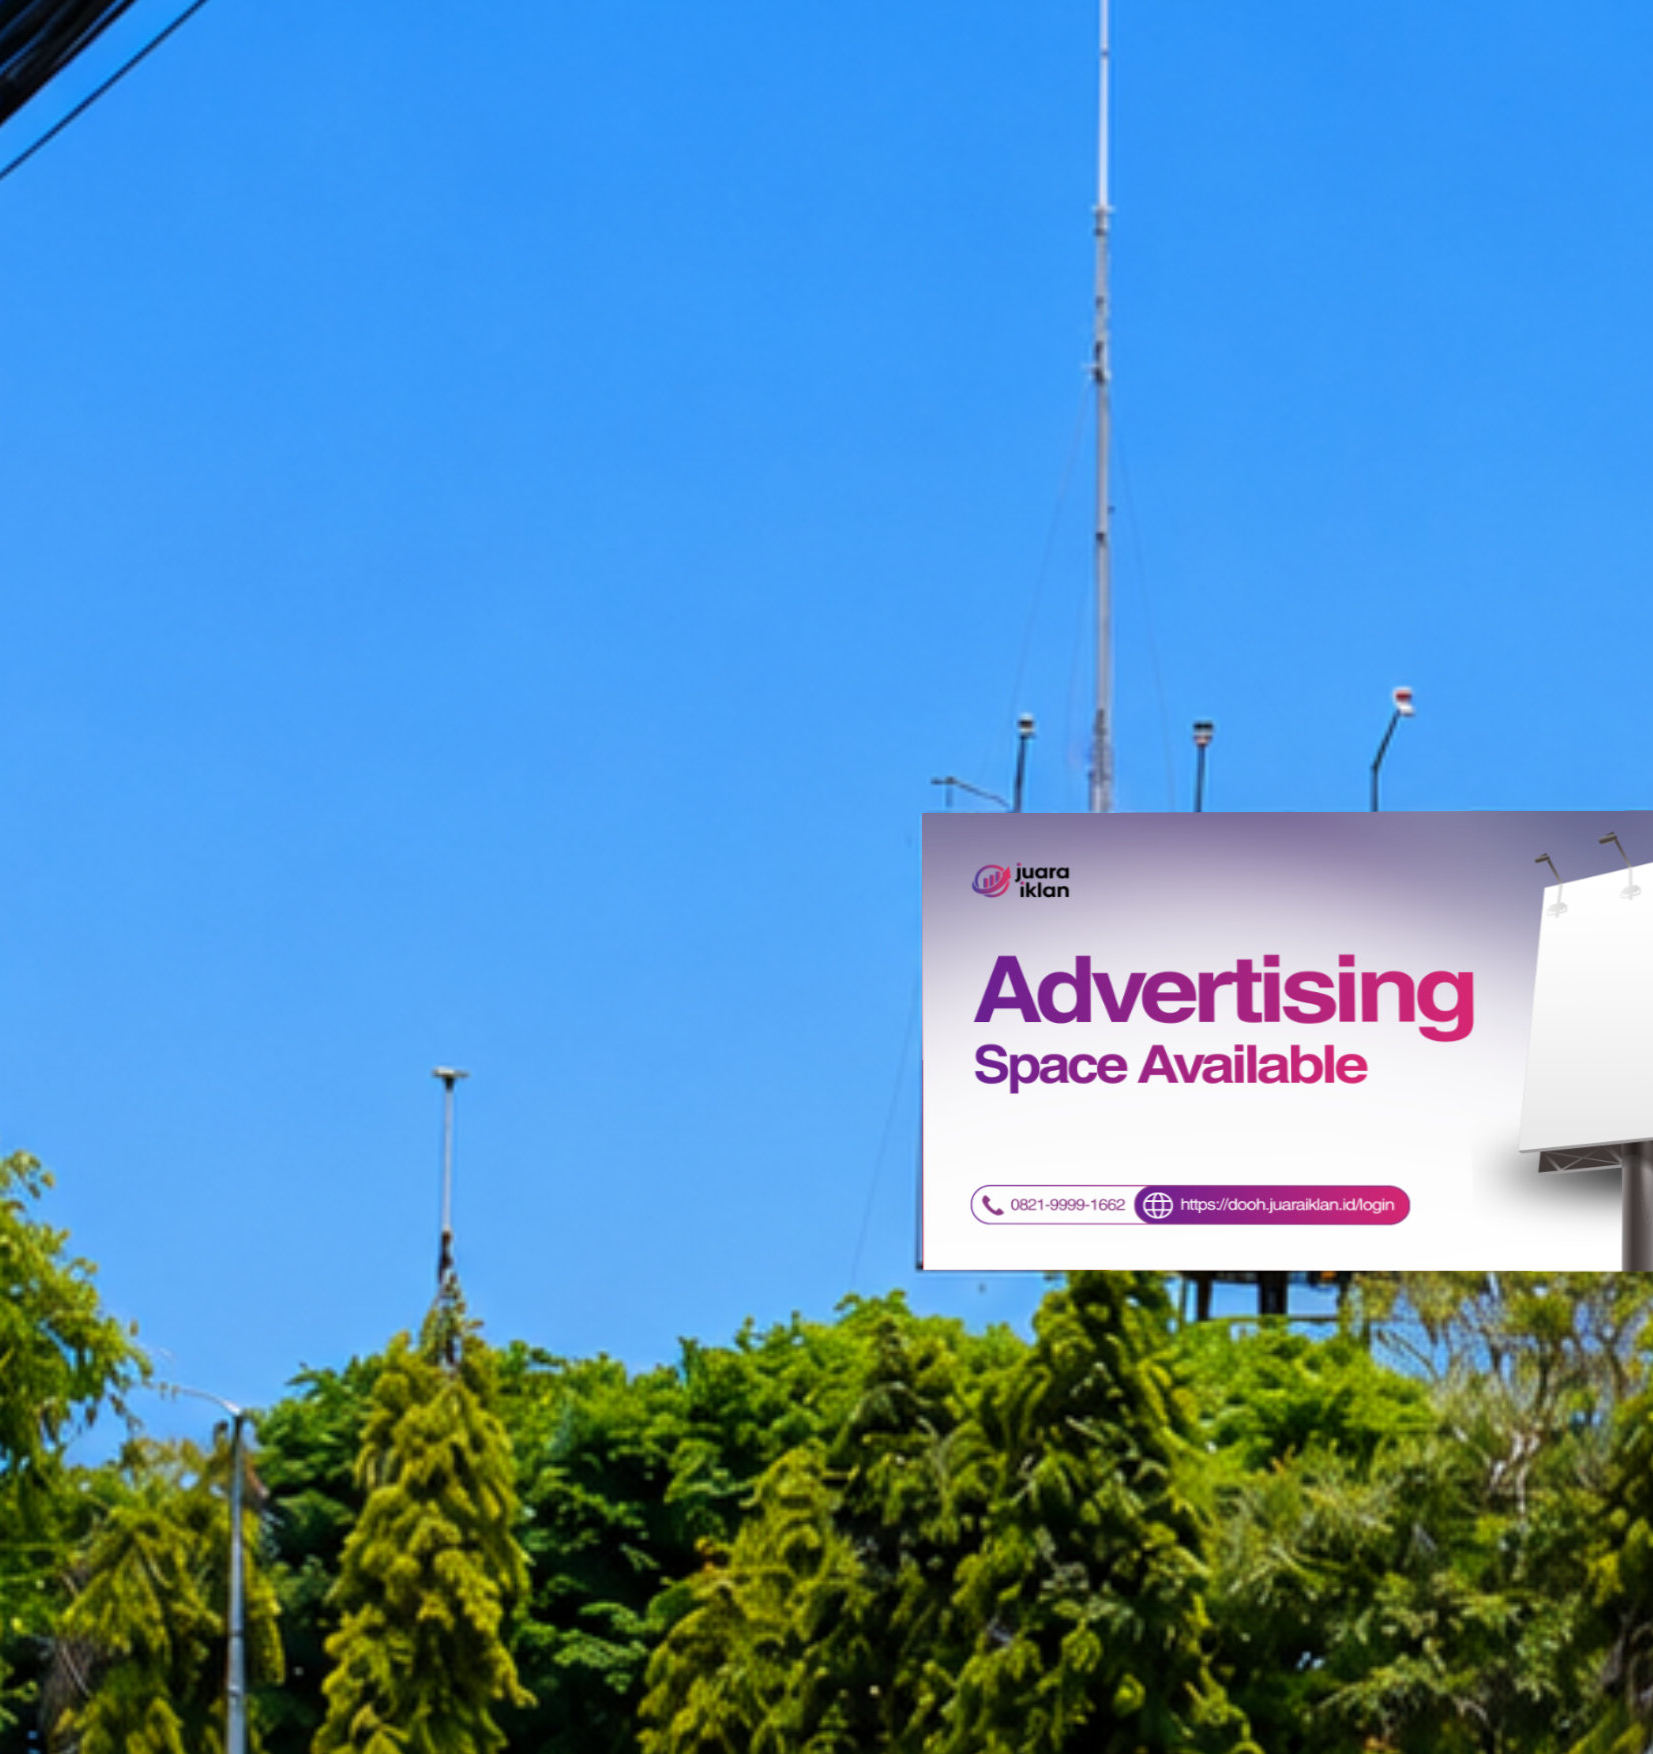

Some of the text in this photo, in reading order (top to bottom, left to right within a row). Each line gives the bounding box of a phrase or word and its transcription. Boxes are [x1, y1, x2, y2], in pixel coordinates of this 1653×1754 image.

[1015, 862, 1069, 883] juara
[1020, 881, 1069, 898] iklan
[973, 954, 1475, 1043] Advertising
[974, 1043, 1369, 1094] Space Available
[1010, 1198, 1126, 1211] 0821-9999-1662
[1180, 1198, 1395, 1214] https://dooh.juaraiklan.id/login
